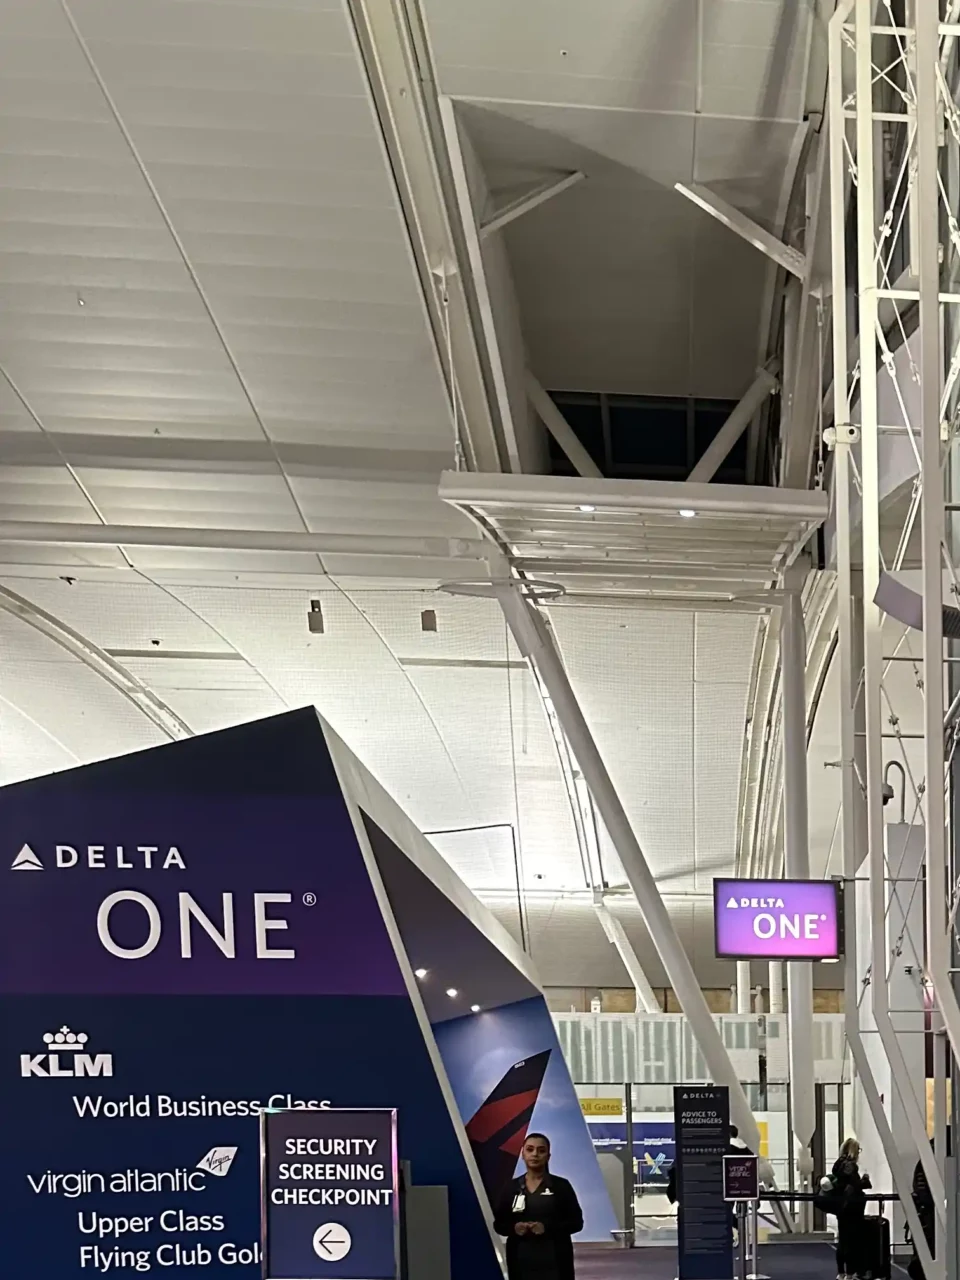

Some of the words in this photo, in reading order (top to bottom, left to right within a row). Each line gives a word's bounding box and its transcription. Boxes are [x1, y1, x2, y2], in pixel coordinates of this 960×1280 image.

[55, 845, 186, 870] DELTA
[740, 897, 785, 909] DELTA
[20, 1053, 114, 1078] KLM
[72, 1095, 151, 1118] World
[157, 1095, 262, 1117] Business
[594, 1103, 620, 1112] Gates
[285, 1138, 377, 1156] SECURITY
[27, 1169, 105, 1198] virgin
[109, 1167, 206, 1193] atlantic
[278, 1163, 385, 1181] SCREENING
[271, 1188, 393, 1206] CHECKPOINT
[77, 1210, 154, 1238] Upper
[160, 1209, 225, 1232] Class
[80, 1245, 151, 1272] Flying
[156, 1244, 212, 1266] Club
[218, 1242, 264, 1265] Gol
